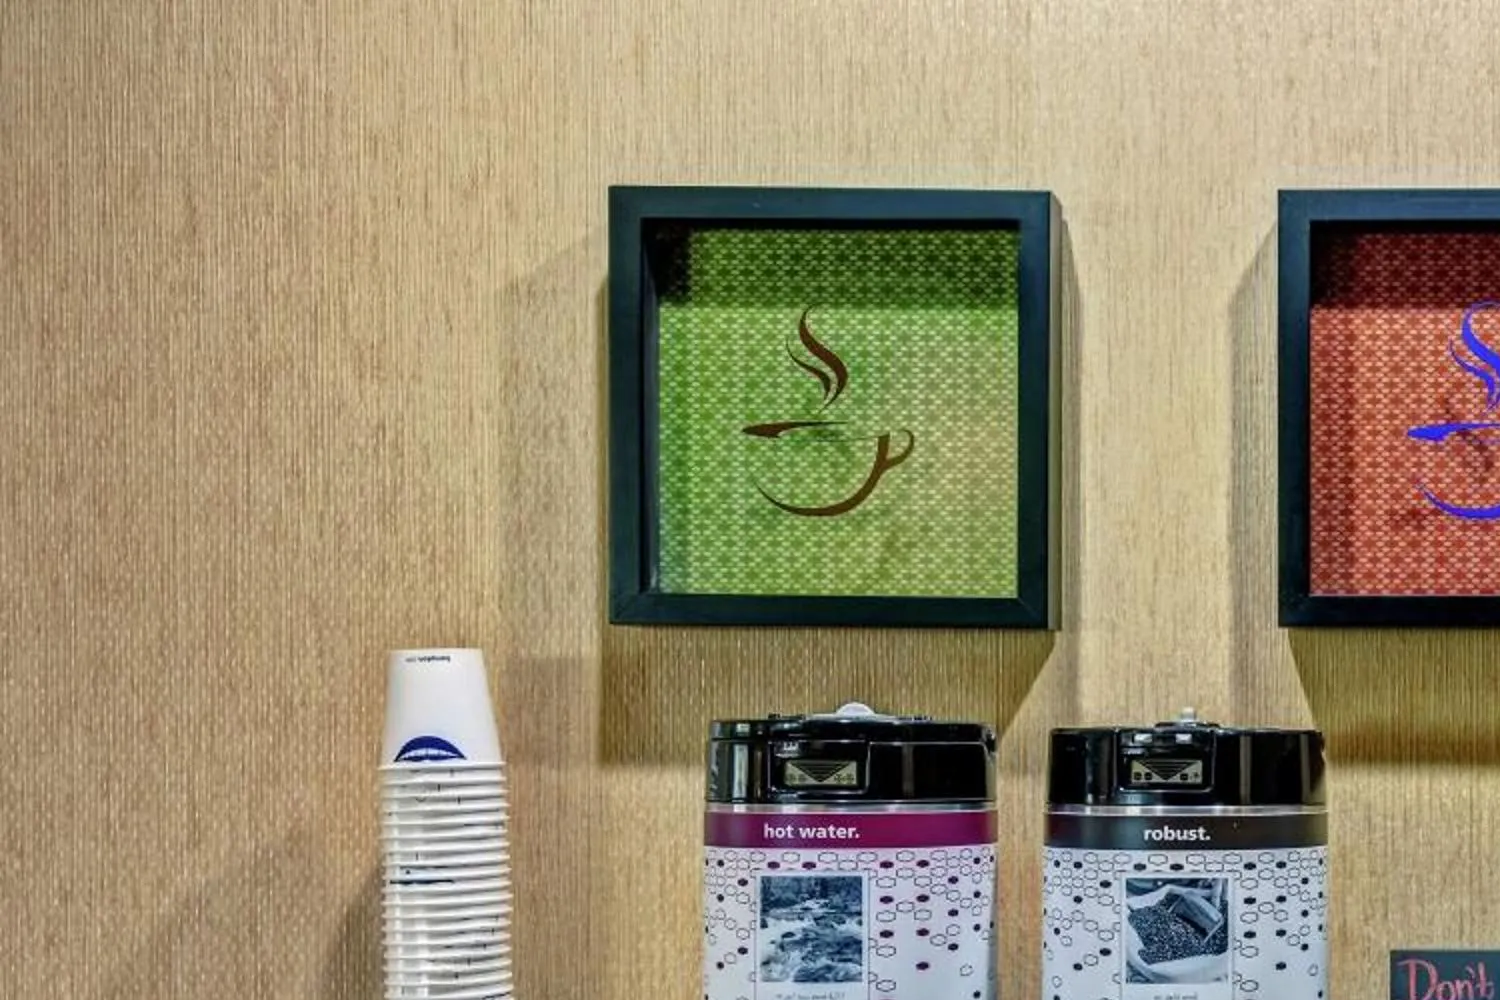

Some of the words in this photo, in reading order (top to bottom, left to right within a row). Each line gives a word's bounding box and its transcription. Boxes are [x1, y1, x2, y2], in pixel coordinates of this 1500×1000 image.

[763, 822, 794, 839] hot
[798, 824, 860, 839] water.
[1143, 825, 1211, 841] robust.
